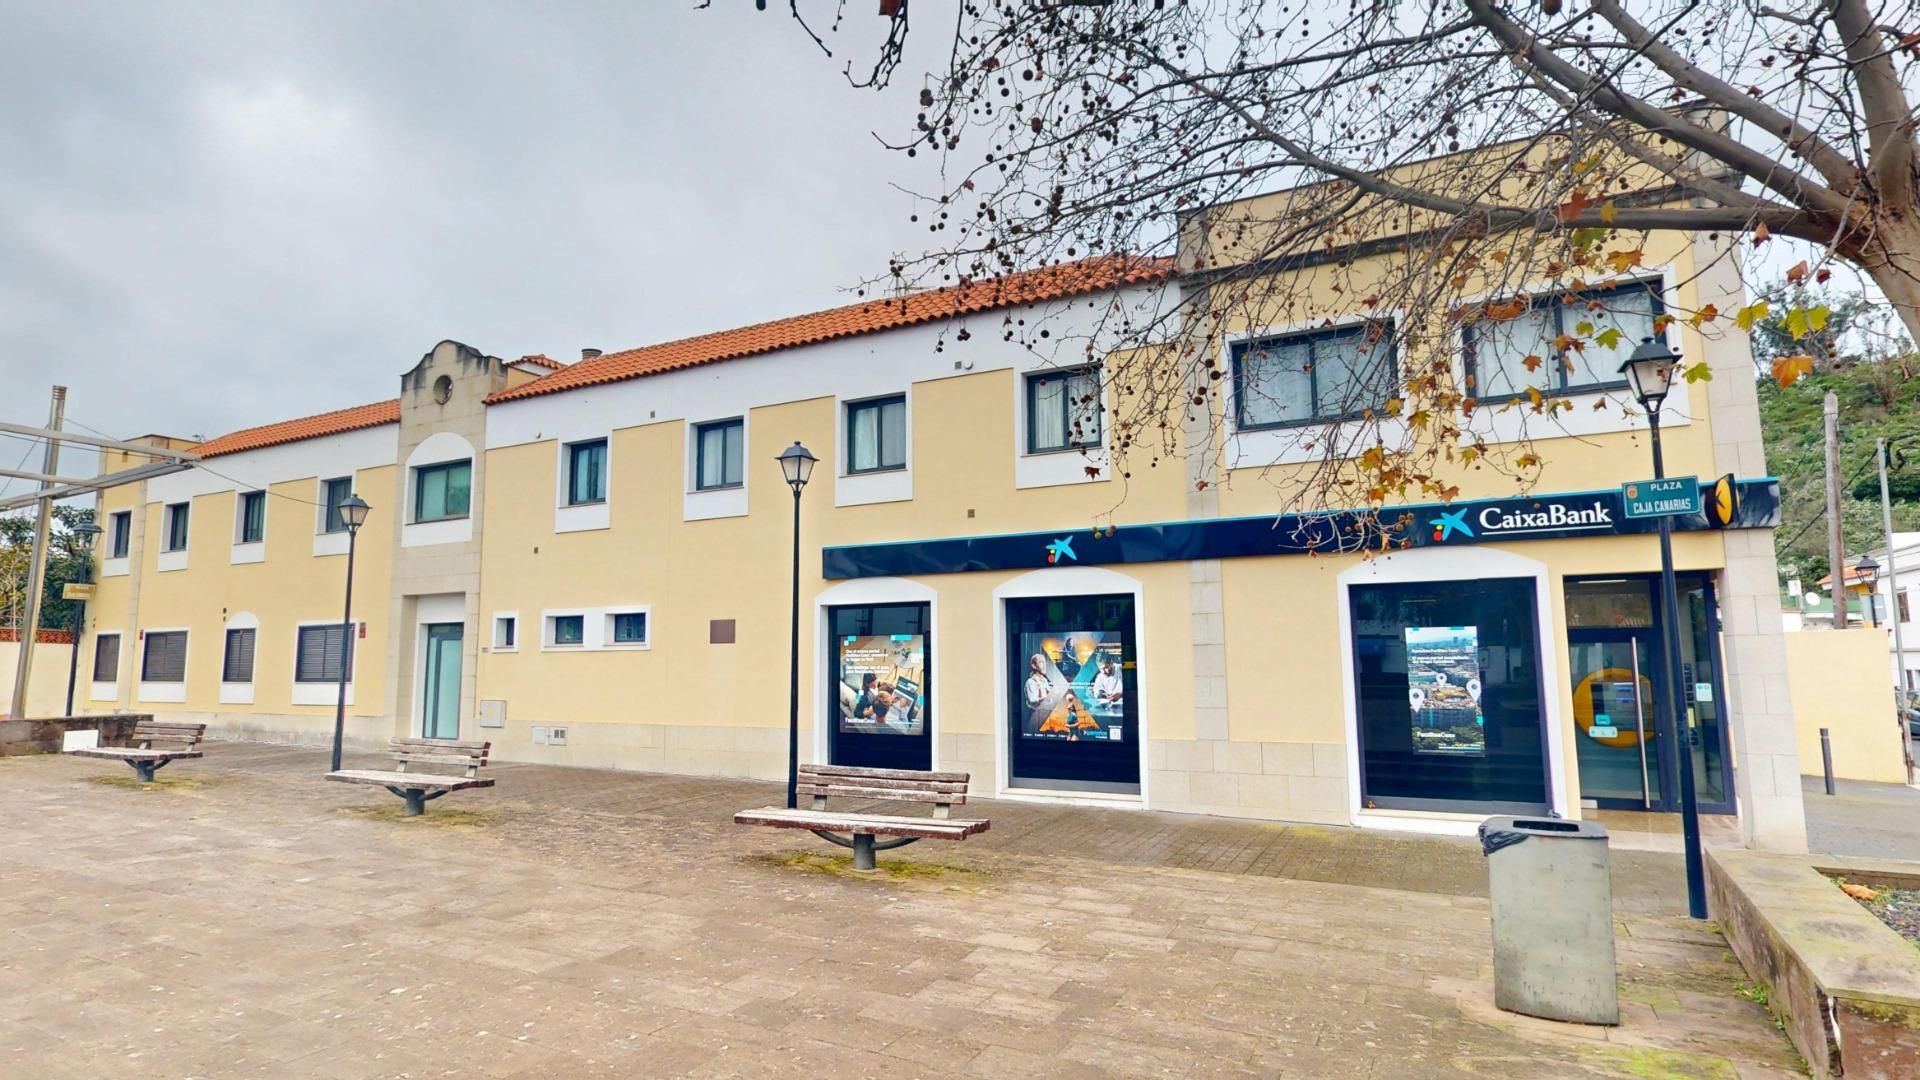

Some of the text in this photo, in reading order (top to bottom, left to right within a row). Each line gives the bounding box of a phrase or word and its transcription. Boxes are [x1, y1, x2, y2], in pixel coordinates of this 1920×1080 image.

[1650, 481, 1683, 491] PLAZA
[1633, 499, 1691, 514] CAJA CANARIAS
[1479, 501, 1612, 530] CaixaBank
